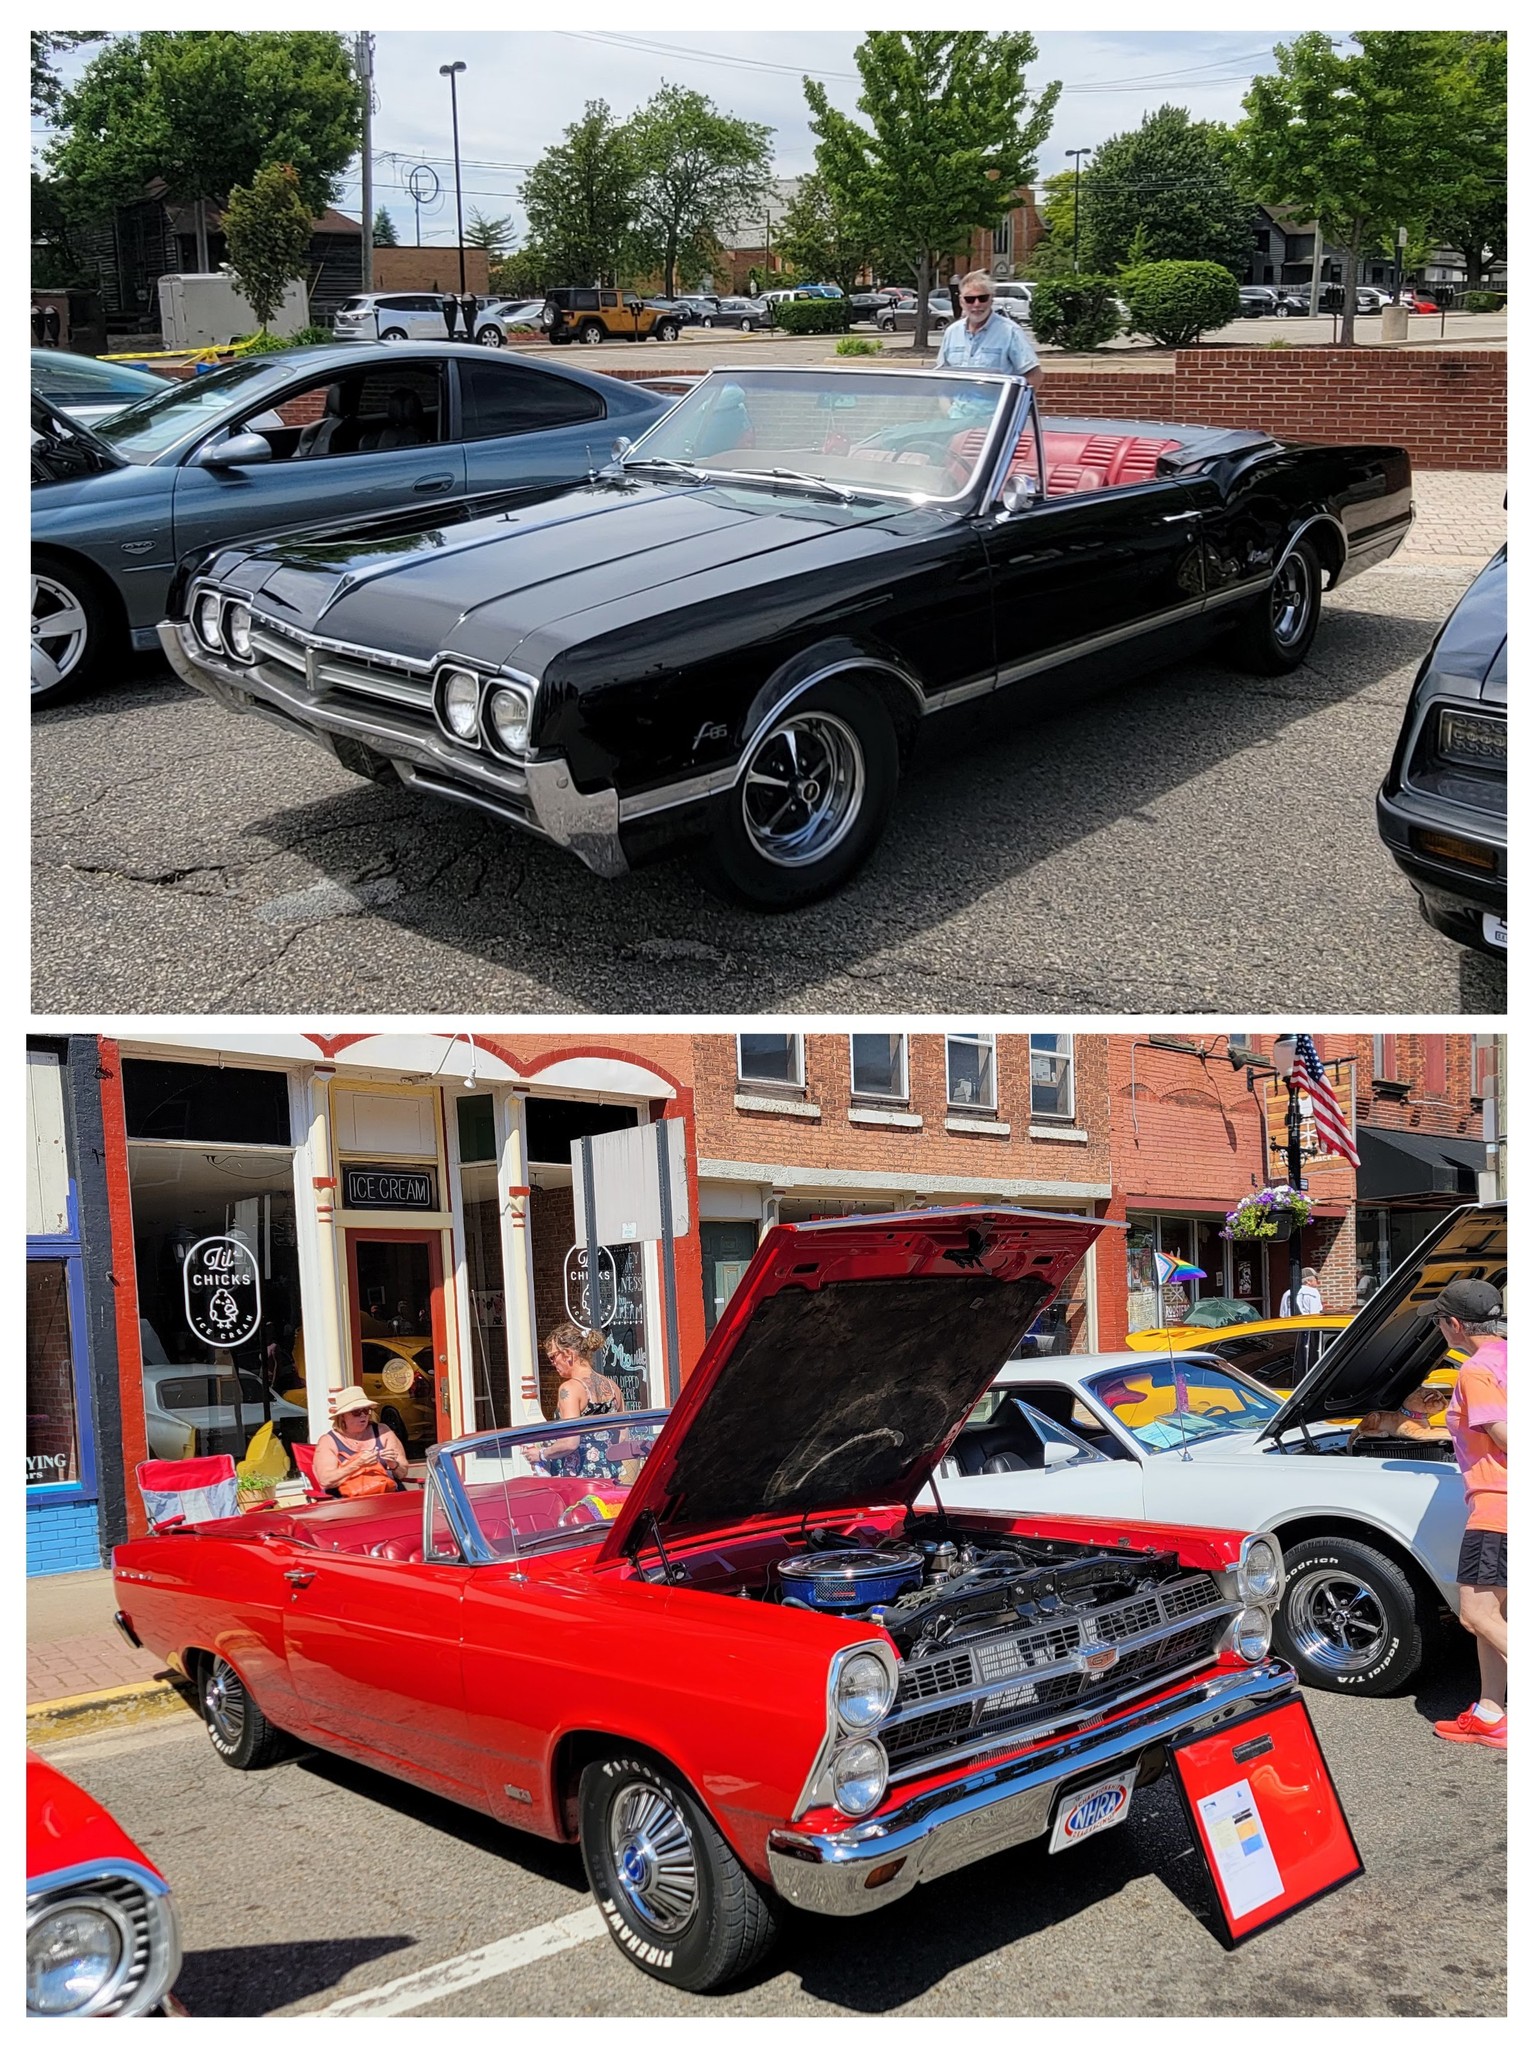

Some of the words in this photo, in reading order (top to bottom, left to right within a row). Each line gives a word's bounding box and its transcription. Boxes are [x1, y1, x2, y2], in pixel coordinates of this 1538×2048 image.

[352, 1176, 376, 1199] ICE
[379, 1177, 426, 1201] CREAM
[203, 1246, 237, 1271] Lil'
[193, 1273, 251, 1286] CHICKS
[569, 1270, 610, 1281] CHIKS
[196, 1316, 213, 1335] ICE
[220, 1314, 253, 1339] CREAM
[1368, 1637, 1400, 1679] Radial
[1336, 1675, 1366, 1683] T/A
[1074, 1793, 1116, 1829] NHRA
[602, 1898, 674, 1968] FIREHAWK
